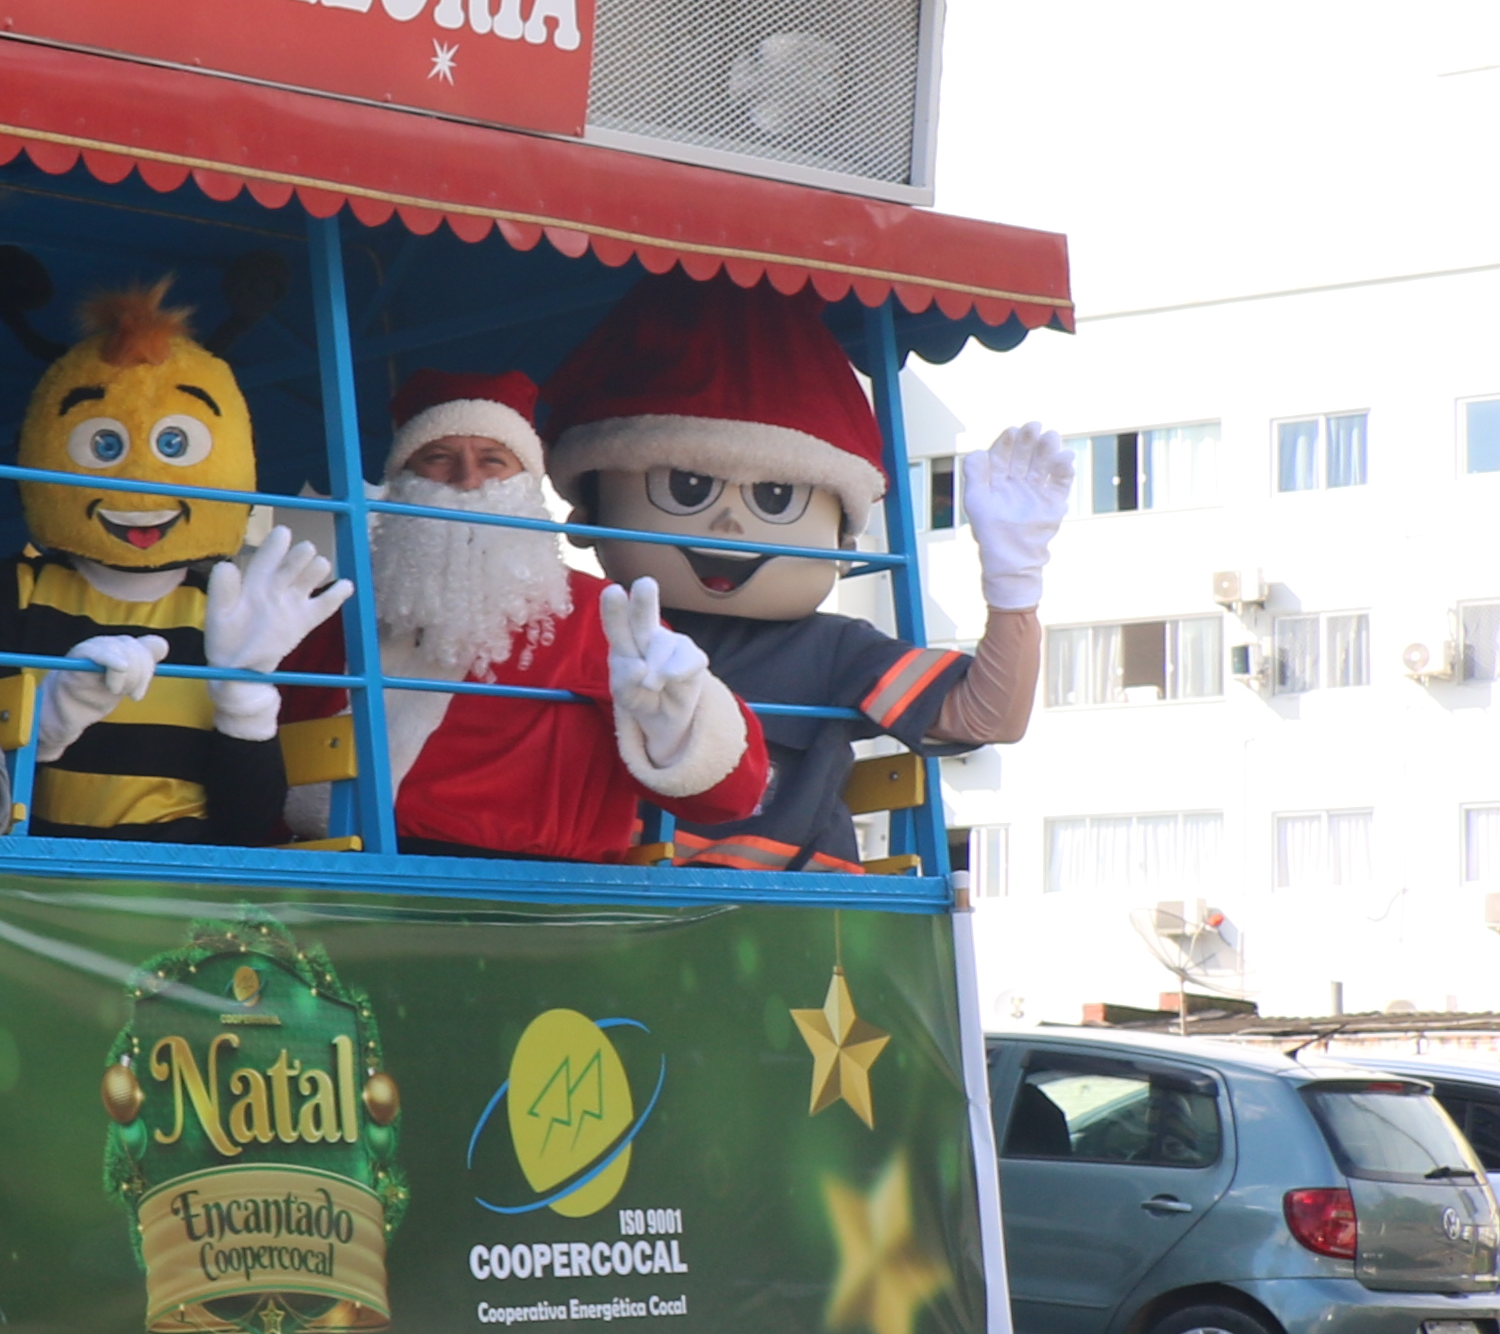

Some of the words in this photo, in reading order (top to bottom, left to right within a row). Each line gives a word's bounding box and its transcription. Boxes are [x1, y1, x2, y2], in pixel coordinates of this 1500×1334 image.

[150, 1032, 359, 1157] Natal
[171, 1185, 355, 1245] Encantado
[619, 1208, 645, 1237] ISO
[647, 1207, 684, 1237] 9001
[199, 1237, 334, 1283] Coopercocal
[469, 1237, 688, 1282] COOPERCOCAL
[477, 1296, 567, 1326] Cooperativa
[570, 1293, 647, 1322] Energética
[649, 1292, 688, 1318] Cocal
